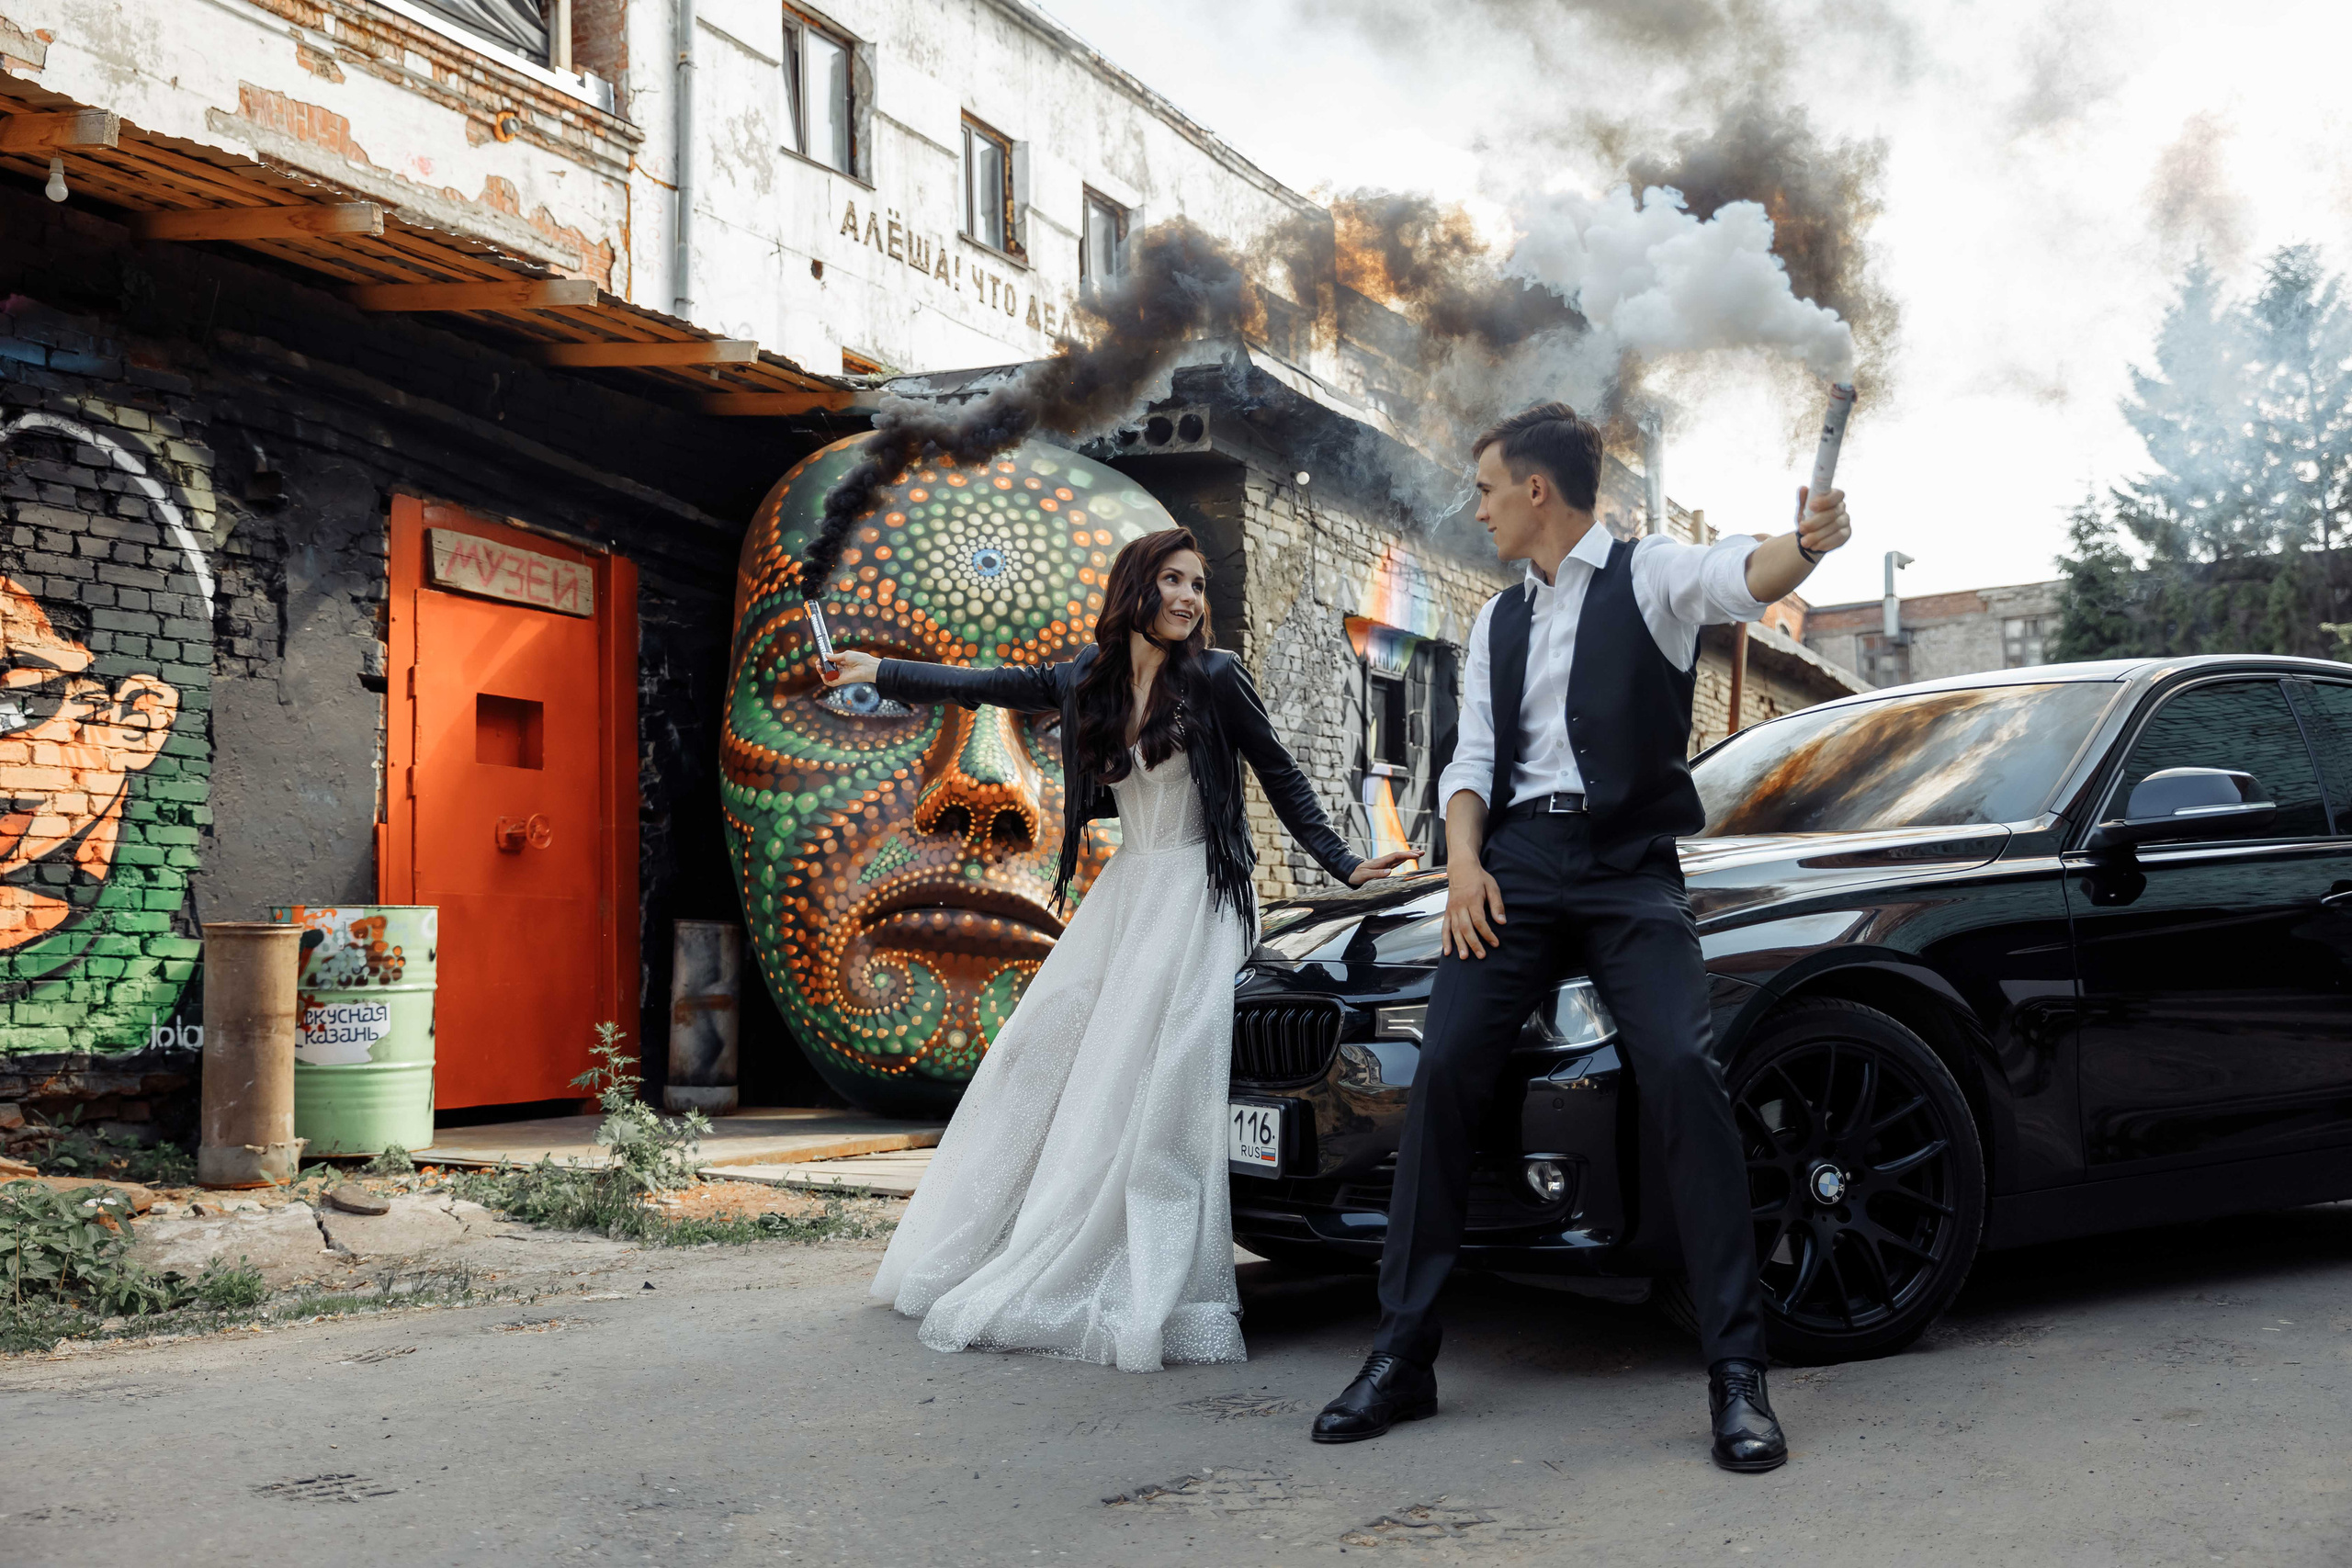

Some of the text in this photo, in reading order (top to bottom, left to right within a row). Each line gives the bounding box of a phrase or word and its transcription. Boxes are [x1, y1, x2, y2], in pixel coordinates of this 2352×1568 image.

[840, 200, 1071, 337] АЛЁША! ЧТО ДЕЛ
[445, 540, 579, 611] МУЗЕЙ
[1234, 1109, 1272, 1145] 116
[1241, 1145, 1261, 1159] RUS
